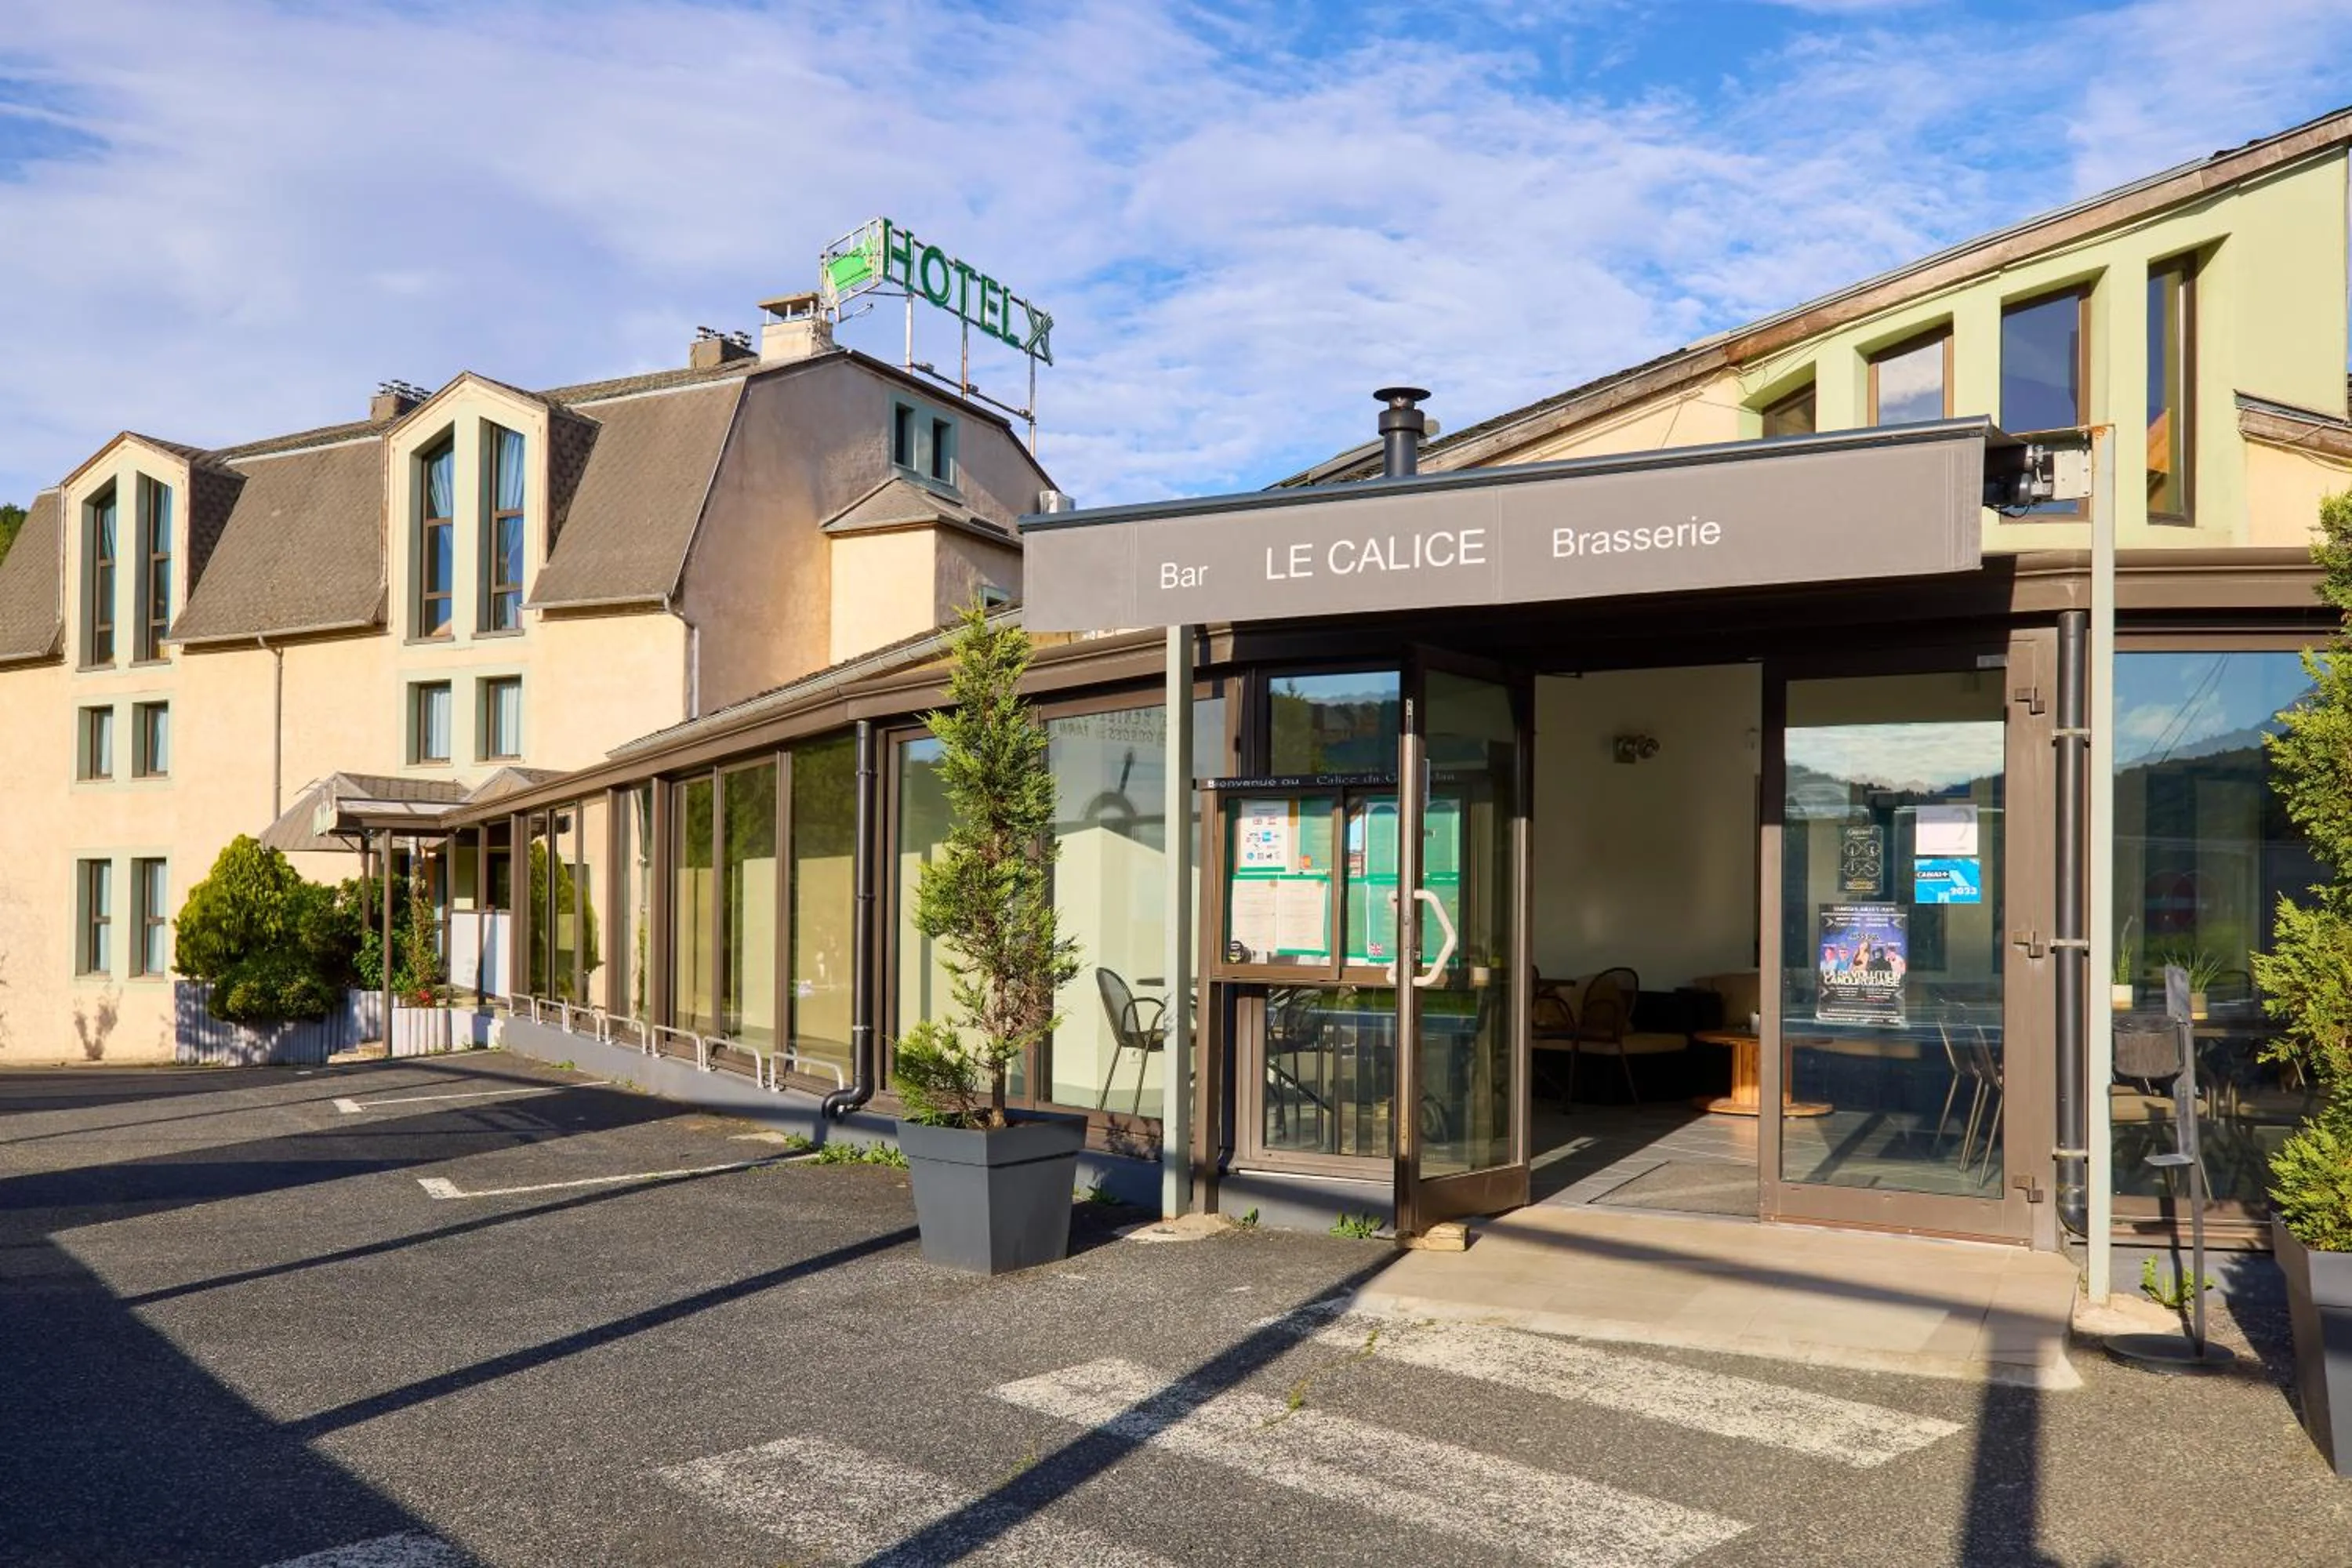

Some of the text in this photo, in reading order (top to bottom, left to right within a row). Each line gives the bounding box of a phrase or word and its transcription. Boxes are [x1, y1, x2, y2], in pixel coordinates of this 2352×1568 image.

[882, 217, 1021, 350] HOTEL
[1265, 528, 1486, 580] LE CALICE
[1552, 517, 1722, 558] Brasserie
[1160, 562, 1209, 590] Bar
[1207, 779, 1277, 789] Bienvenue
[1316, 774, 1358, 785] Calice
